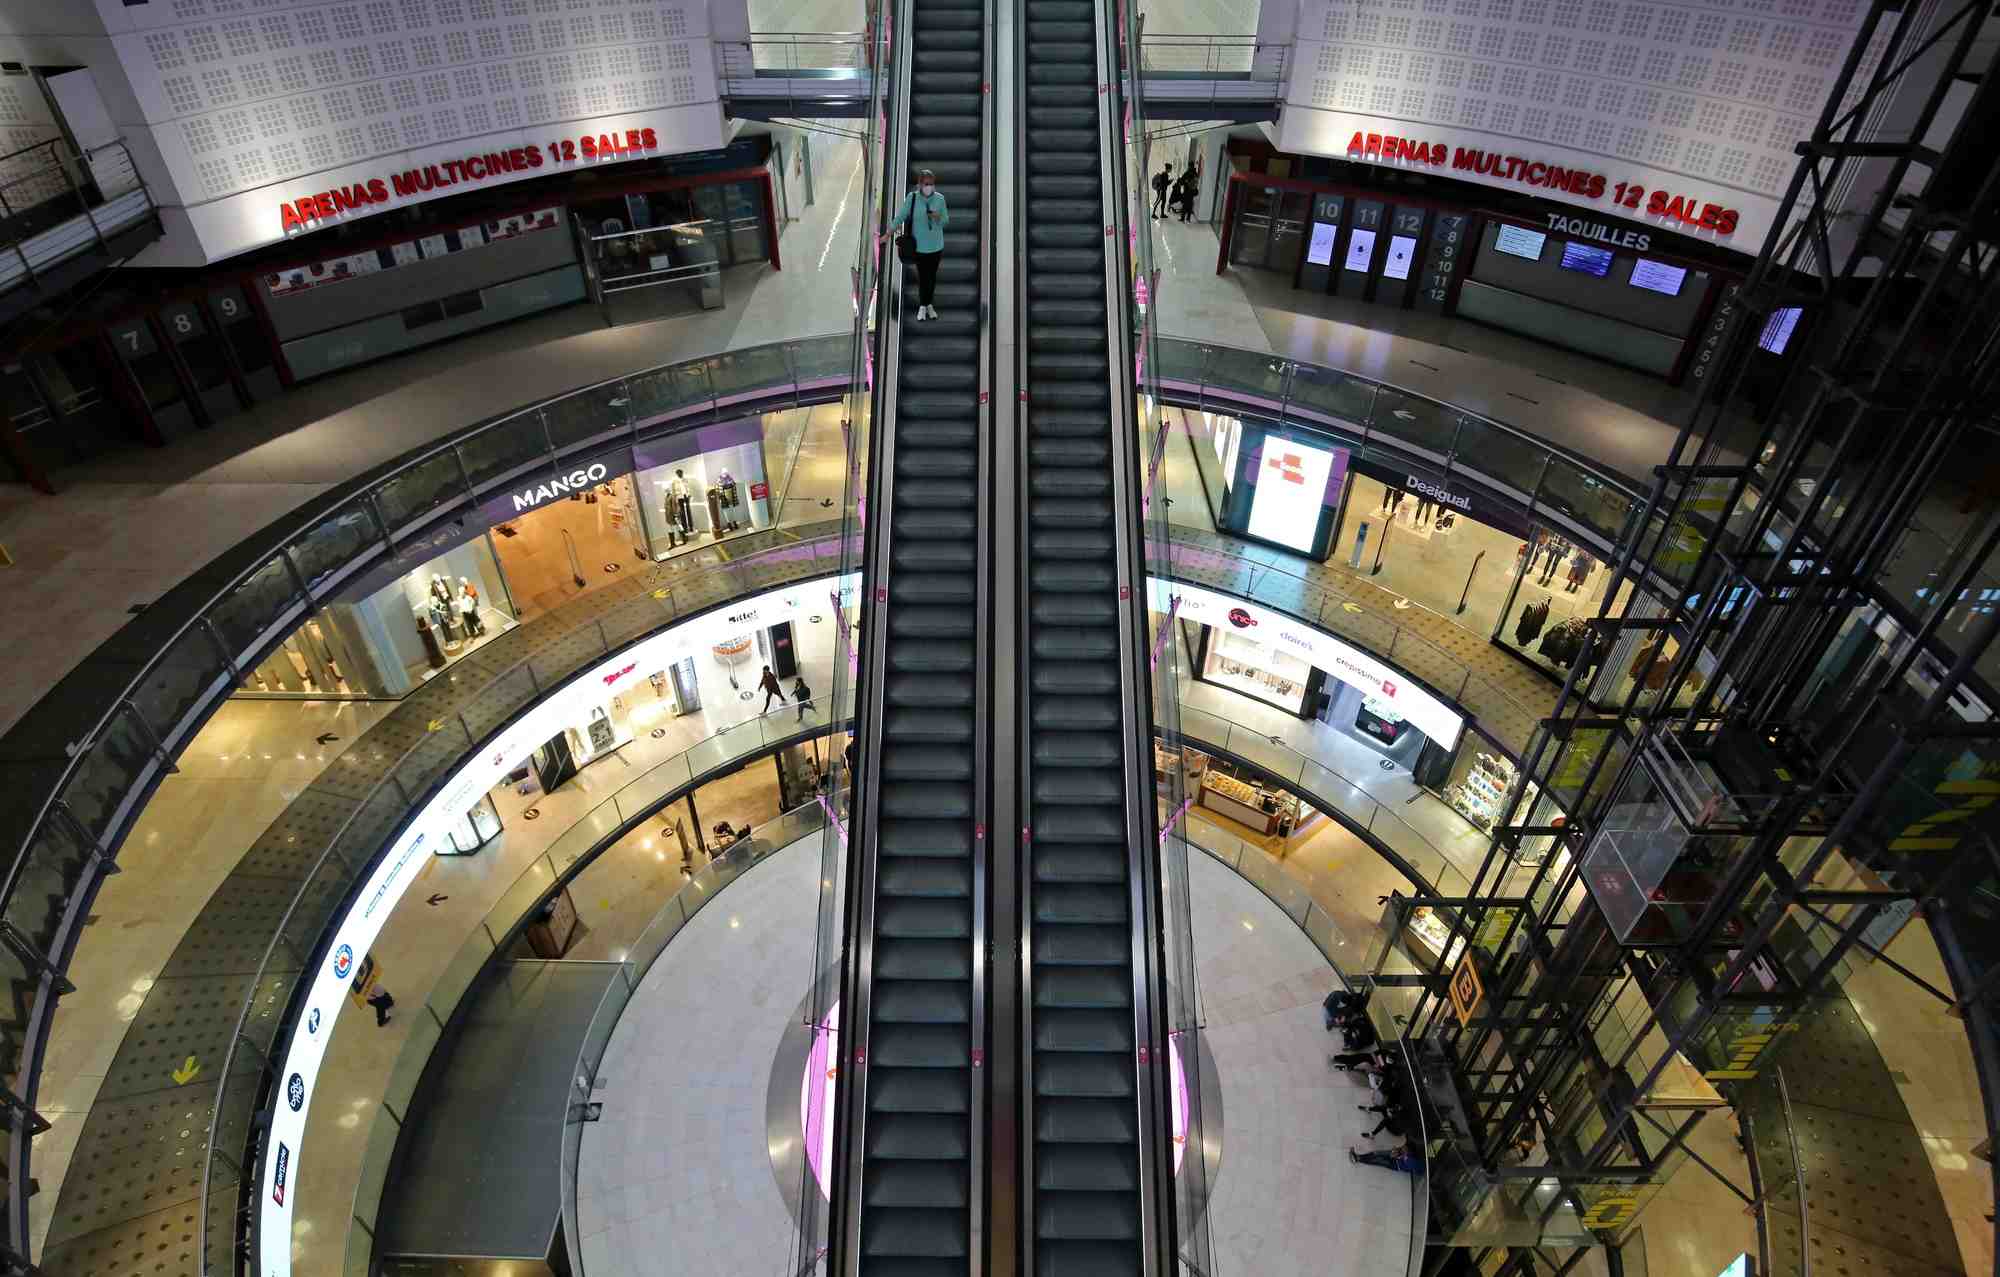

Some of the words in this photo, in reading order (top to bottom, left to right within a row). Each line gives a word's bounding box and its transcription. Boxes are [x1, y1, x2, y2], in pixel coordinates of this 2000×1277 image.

[280, 178, 389, 231] ARENAS
[391, 145, 544, 197] MULTICINES
[548, 140, 577, 162] 12
[580, 127, 658, 158] SALES
[1347, 131, 1448, 166] ARENAS
[1453, 147, 1606, 199] MULTICINES
[1614, 182, 1645, 209] 12
[1647, 190, 1740, 235] SALES
[1319, 201, 1338, 218] 10
[1360, 208, 1377, 225] 11
[1398, 214, 1420, 232] 12
[1451, 216, 1463, 228] 7
[1447, 231, 1457, 242] 8
[1547, 213, 1651, 251] TAQUILLES
[1444, 246, 1454, 257] 9
[1438, 260, 1452, 273] 10
[1433, 275, 1447, 287] 11
[1430, 289, 1445, 301] 12
[221, 297, 237, 316] 9
[1720, 303, 1732, 315] 2
[175, 314, 192, 333] 8
[1713, 318, 1726, 331] 3
[122, 330, 139, 350] 7
[1706, 335, 1718, 347] 4
[1700, 350, 1712, 362] 5
[1693, 366, 1705, 378] 6
[512, 463, 607, 512] MANGO
